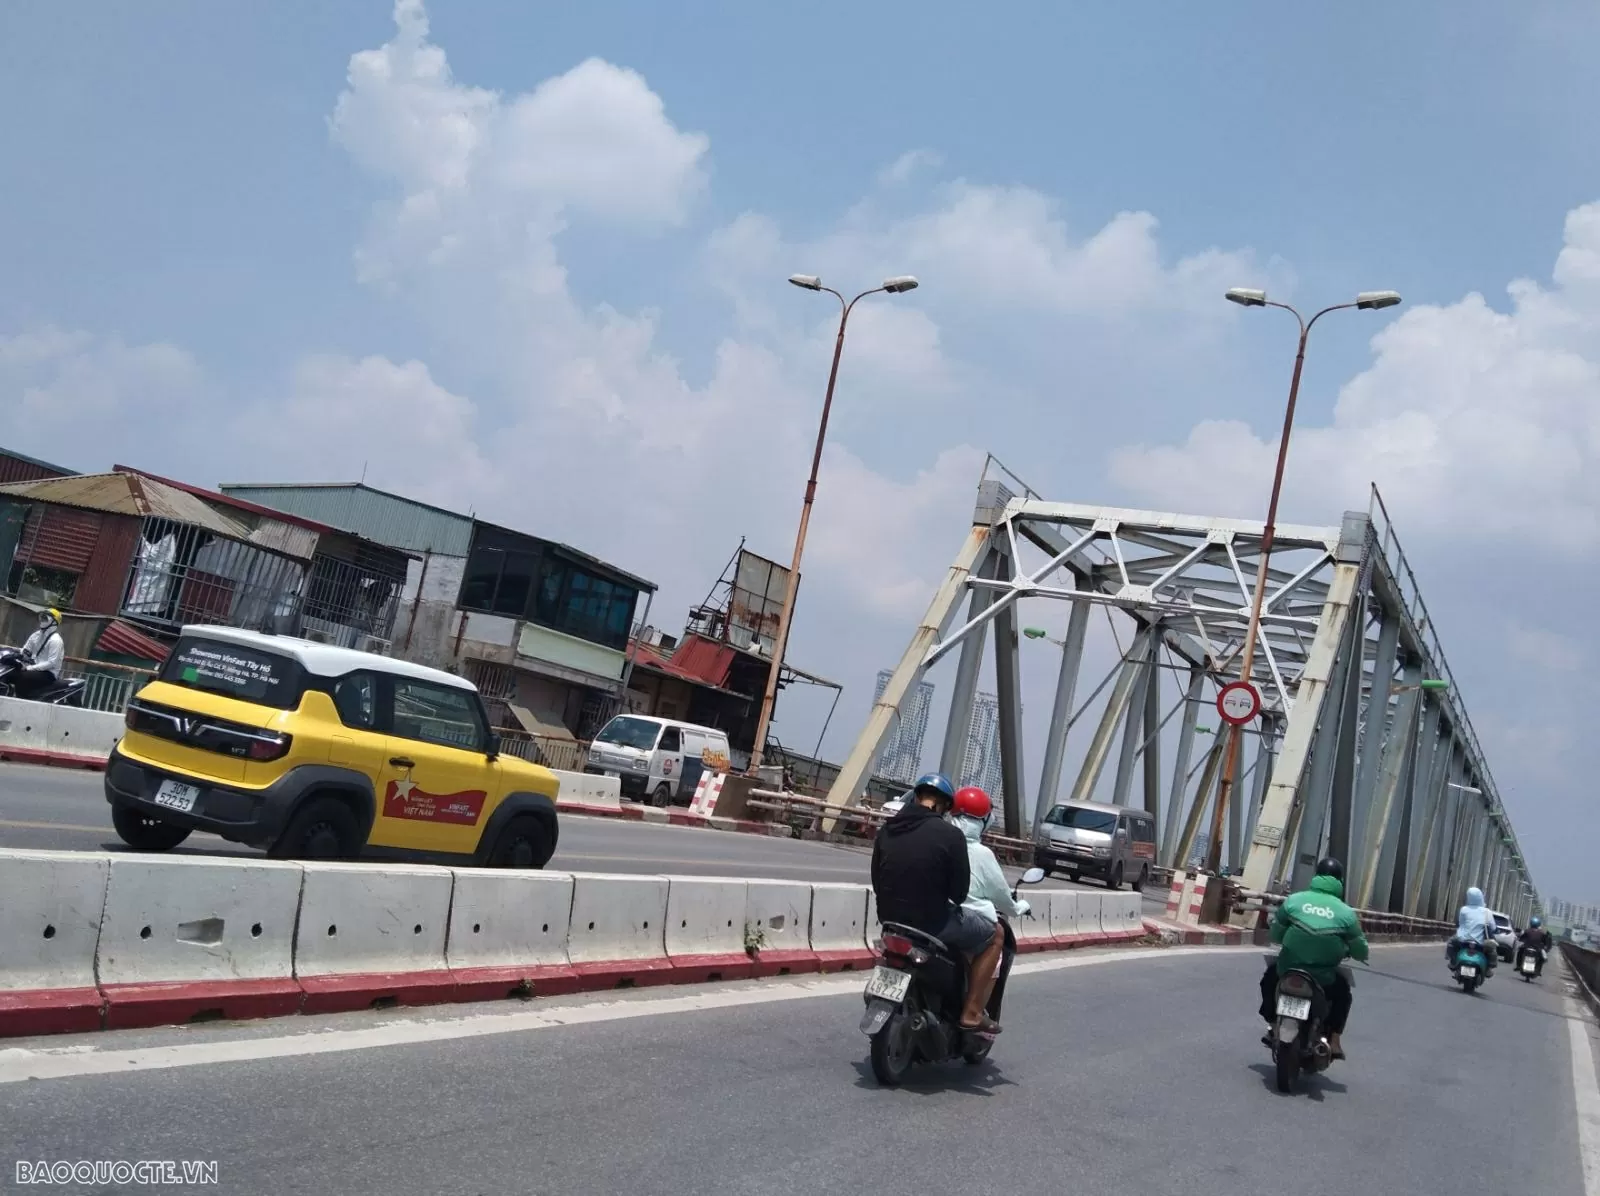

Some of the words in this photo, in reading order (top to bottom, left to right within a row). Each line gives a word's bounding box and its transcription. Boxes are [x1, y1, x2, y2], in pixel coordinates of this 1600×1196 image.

[190, 647, 221, 660] Showroom
[222, 654, 247, 668] VinFast
[246, 660, 260, 672] Tây
[259, 664, 272, 673] Hồ
[170, 782, 190, 796] 30M
[159, 792, 190, 810] 522.53
[1302, 903, 1335, 920] Grab
